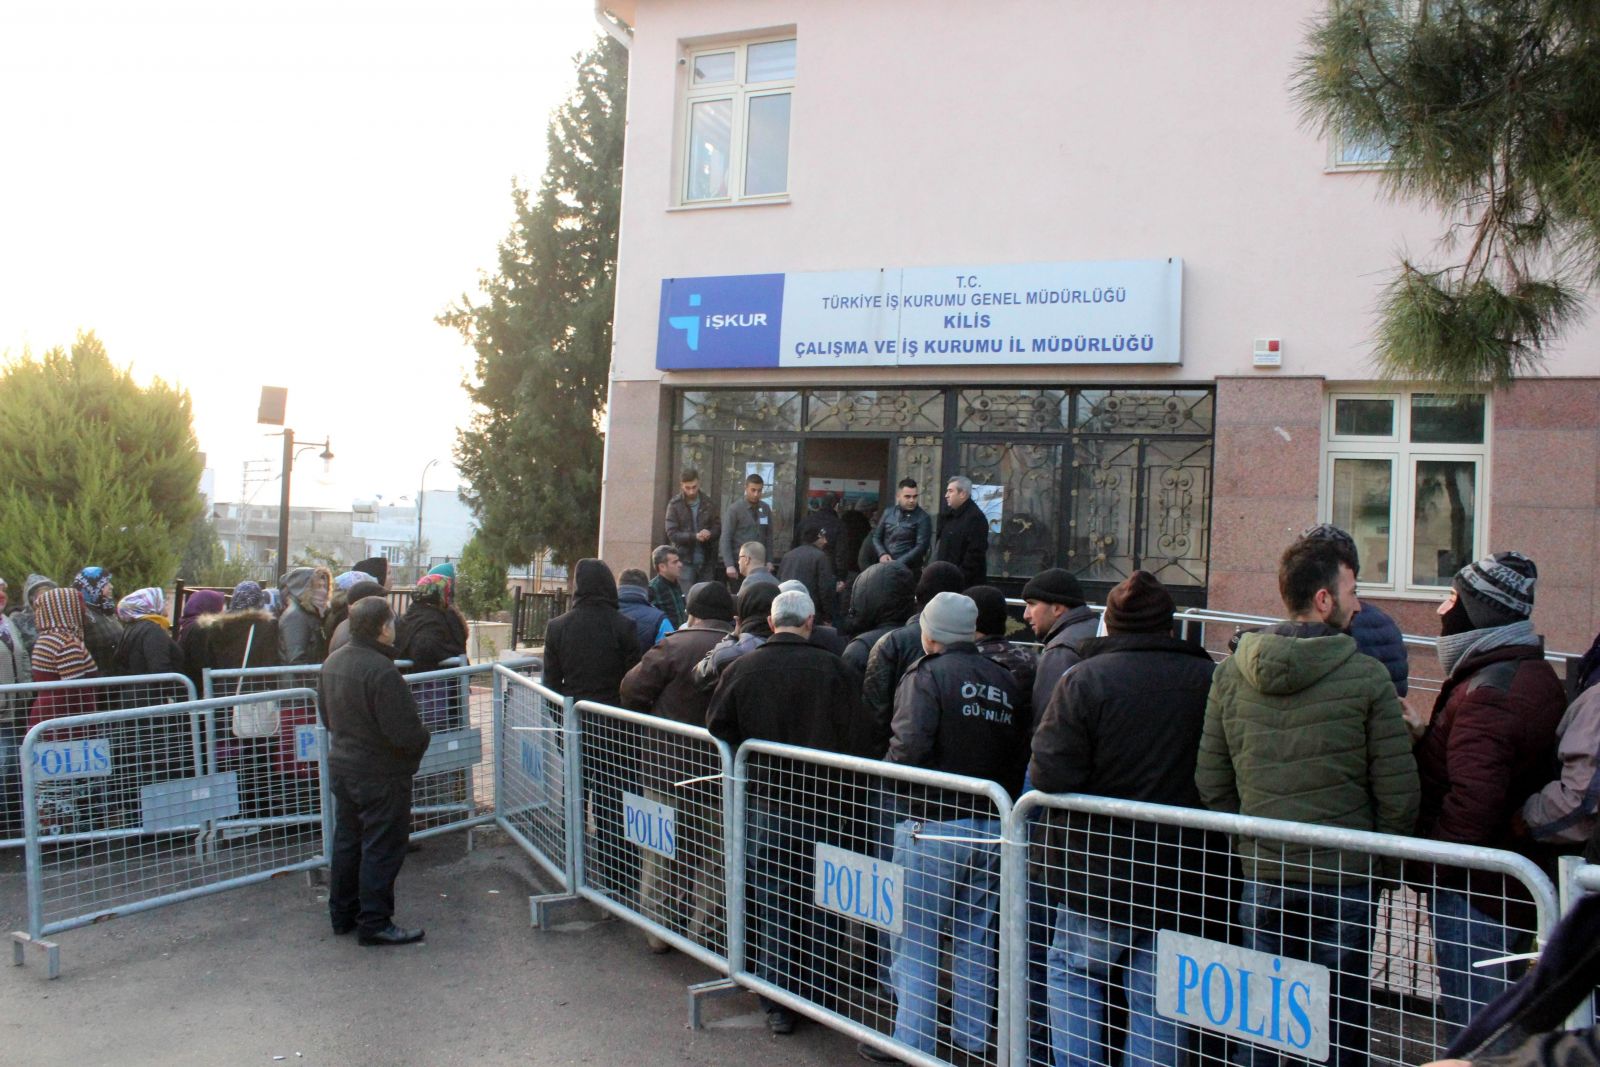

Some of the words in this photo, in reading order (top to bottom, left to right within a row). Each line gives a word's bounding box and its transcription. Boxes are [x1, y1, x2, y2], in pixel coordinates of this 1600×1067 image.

[956, 276, 982, 288] T.C.
[822, 294, 882, 310] TÜRKİYE
[886, 292, 899, 311] İŞ
[903, 294, 966, 308] KURUMU
[971, 292, 1021, 306] GENEL
[1026, 288, 1127, 304] MÜDÜRLÜĞÜ
[944, 312, 991, 329] KİLİS
[795, 340, 868, 359] ÇALIŞMA
[874, 340, 897, 354] VE
[902, 337, 918, 358] İŞ
[924, 339, 1003, 354] KURUMU
[1009, 336, 1026, 353] İL
[1031, 334, 1154, 353] MÜDÜRLÜĞÜ
[961, 681, 1014, 709] ÖZEL
[626, 805, 674, 855] POLİS
[822, 861, 895, 925] POLİS
[1175, 953, 1312, 1049] POLİS
